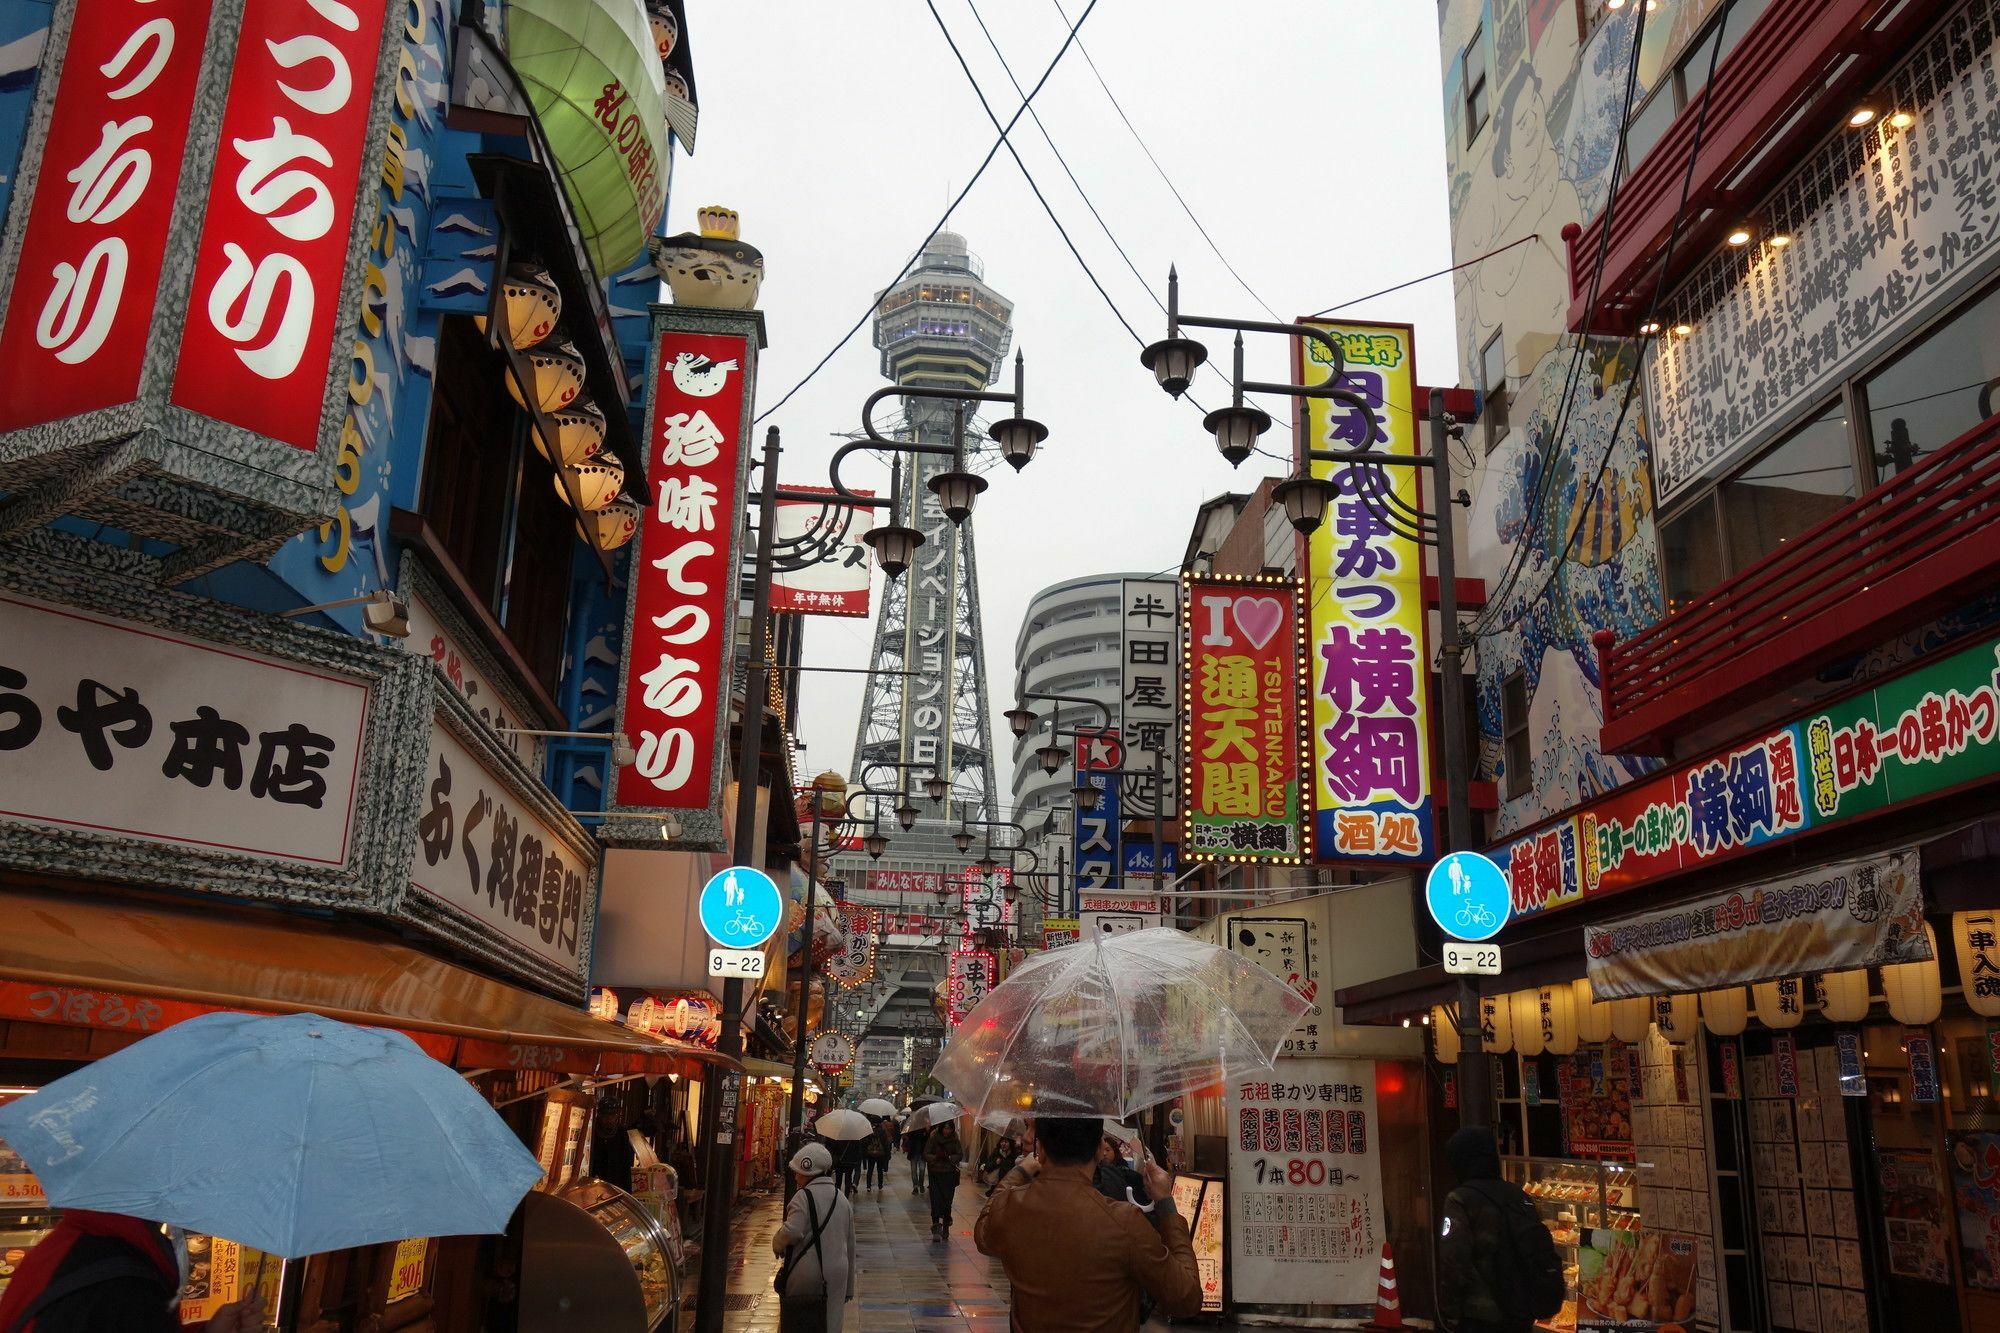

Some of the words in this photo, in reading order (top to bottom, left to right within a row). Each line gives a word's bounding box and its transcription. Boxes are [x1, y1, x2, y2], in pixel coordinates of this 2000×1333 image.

[1926, 158, 1962, 271] いか
[1966, 120, 2000, 242] ホルモン
[1860, 219, 1890, 331] キス
[1875, 200, 1908, 315] 貝柱
[1892, 185, 1922, 302] サーモン
[1909, 176, 1943, 287] たこ
[1829, 250, 1857, 350] かぼちゃ
[1843, 230, 1871, 341] 海老
[1311, 333, 1402, 367] 新世界
[1744, 318, 1767, 421] 銀杏
[1759, 310, 1779, 409] 白ねぎ
[1774, 299, 1794, 397] さつま芋
[1785, 286, 1809, 387] じゃが芋
[1688, 374, 1703, 465] にんにく
[1698, 363, 1715, 458] 玉ねぎ
[1709, 353, 1728, 448] 山芋
[1733, 333, 1754, 431] れんこん
[1654, 405, 1671, 492] もち
[1665, 395, 1680, 483] うずら玉子
[1676, 379, 1694, 476] 紅しょうが
[1329, 371, 1398, 619] 日本の串かつ
[793, 591, 845, 607] 年中無休
[1202, 596, 1232, 647] I
[1125, 593, 1174, 798] 半田屋酒店
[1202, 654, 1260, 816] 通天閣
[1264, 656, 1286, 817] TSUTENKAKU
[1321, 626, 1422, 804] 横綱
[1769, 735, 1801, 828] 酒処
[1811, 719, 1839, 813] 新世界
[1834, 691, 1995, 789] 日本一の串かつ
[1195, 825, 1230, 835] 日本一の
[1196, 836, 1229, 847] 串かつ
[1230, 821, 1287, 852] 横綱
[1338, 813, 1421, 854] 酒処
[1599, 805, 1688, 869] 日本一の串かつ
[1688, 747, 1774, 851] 横綱
[1511, 831, 1562, 911] 横綱
[1560, 826, 1579, 895] 酒処
[1585, 819, 1600, 886] 新世界
[850, 914, 870, 967] 串かつ
[1047, 931, 1071, 941] 新世界
[1084, 899, 1157, 911] 元祖串カツ専門店
[712, 955, 762, 973] 9-22
[965, 959, 986, 1011] 串かつ
[1448, 950, 1499, 969] 9-22
[1778, 980, 1800, 1014] 御礼
[1540, 1002, 1553, 1042] 串かつ
[1239, 1082, 1363, 1103] 元祖串カツ専門店
[1242, 1108, 1259, 1151] 大阪名物
[1264, 1110, 1280, 1151] 串カツ
[1306, 1111, 1323, 1152] 焼きそば
[1329, 1112, 1343, 1153] たこ焼き
[1349, 1114, 1364, 1153] 味自慢
[7, 1183, 46, 1198] 3,50
[214, 1240, 222, 1294] れぞ天下の天然物
